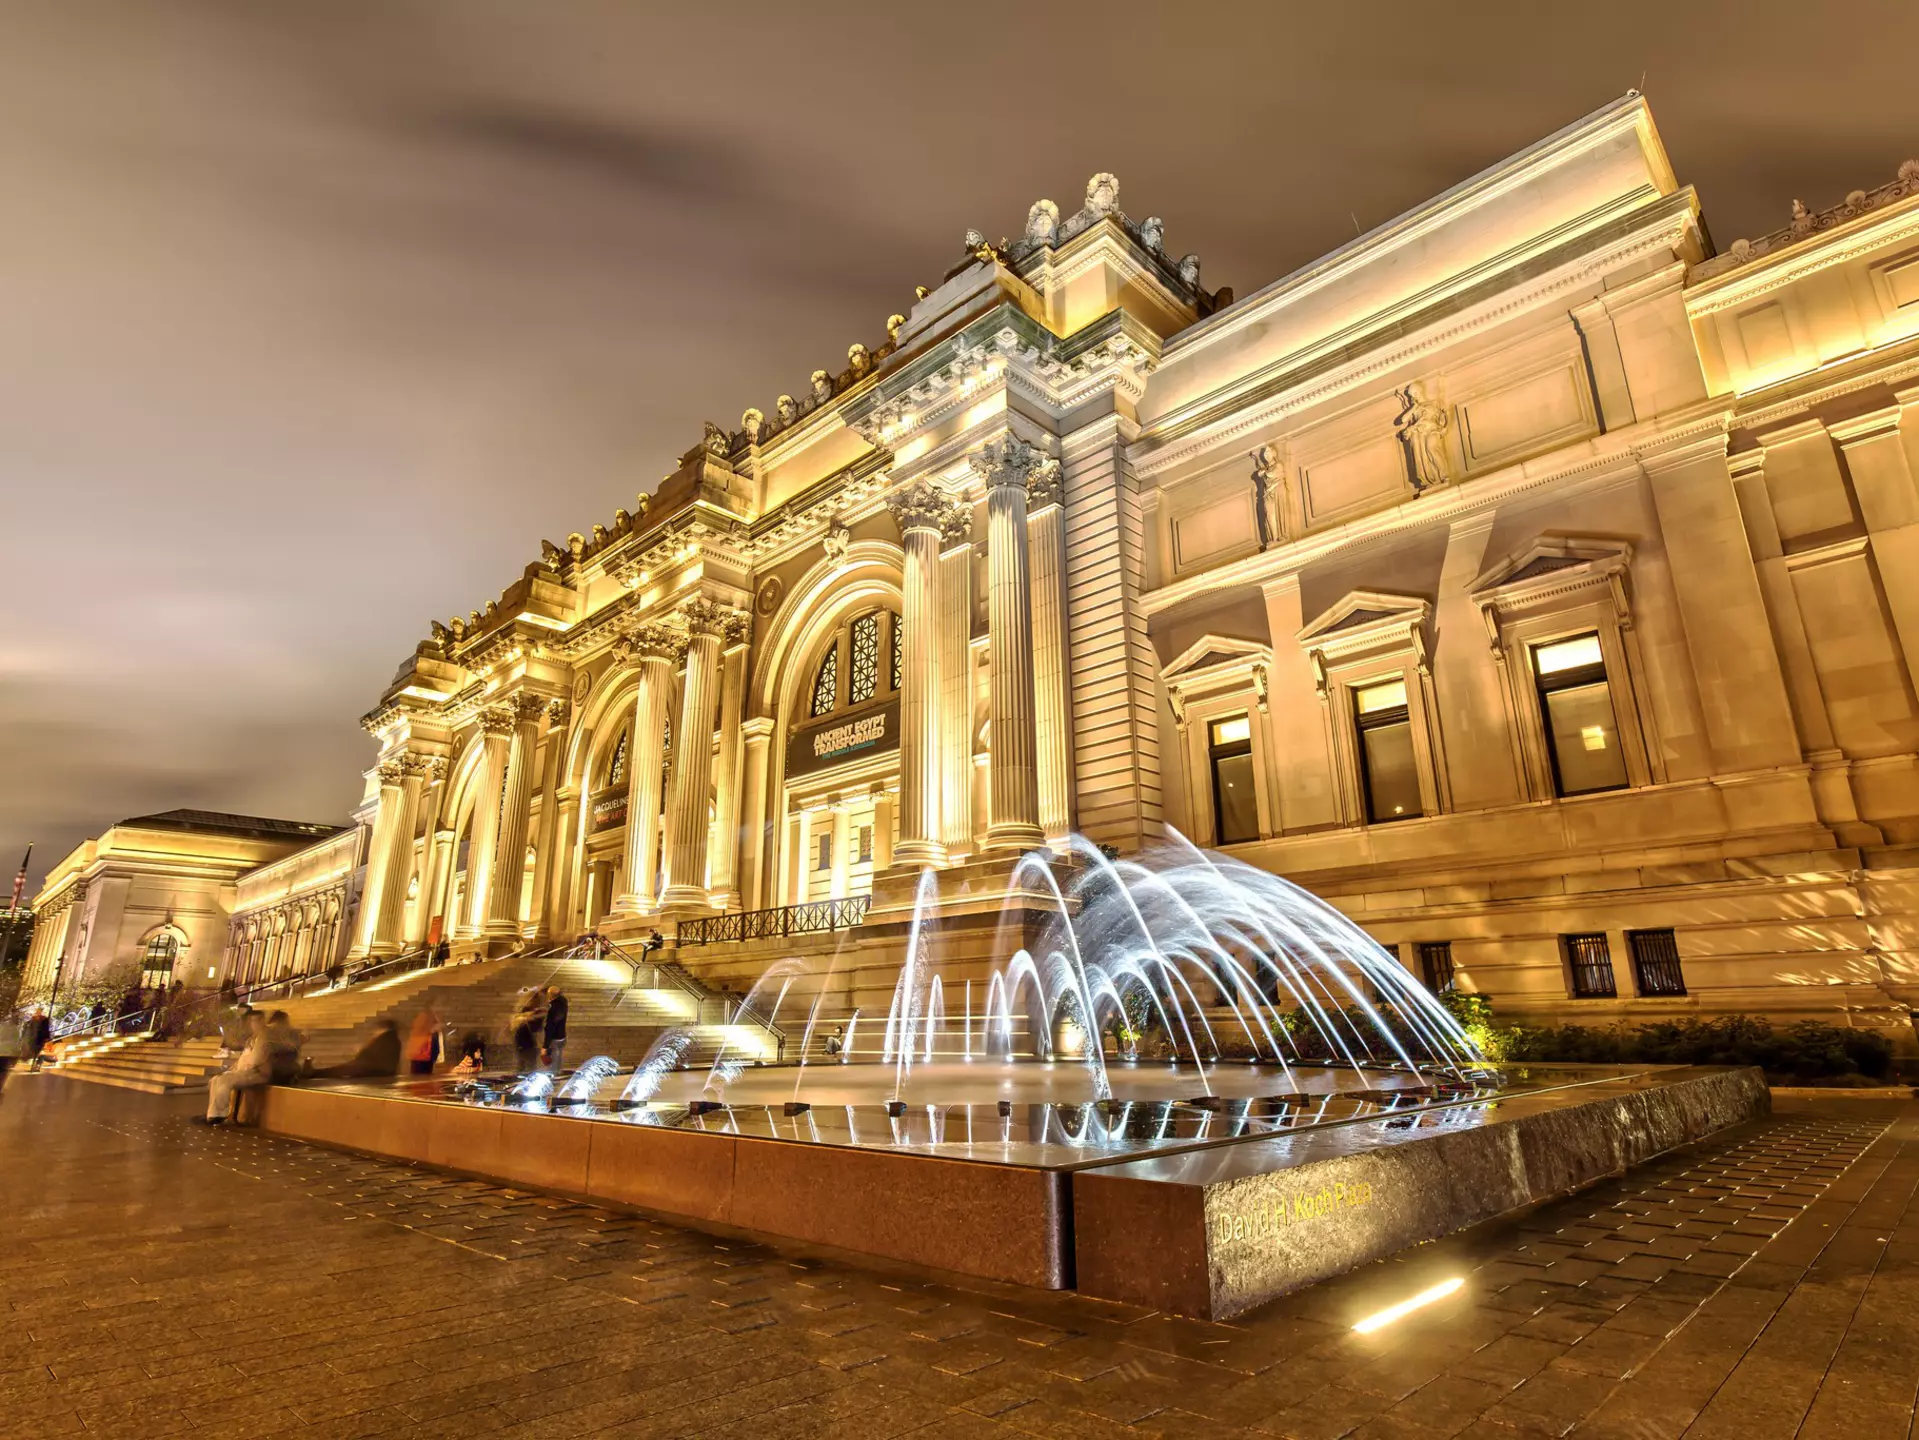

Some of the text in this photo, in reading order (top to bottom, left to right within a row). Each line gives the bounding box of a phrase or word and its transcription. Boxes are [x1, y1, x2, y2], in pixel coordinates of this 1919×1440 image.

[813, 713, 886, 747] ANCIENT EGYPT
[814, 726, 885, 757] TRANSFORMED
[1219, 1202, 1270, 1245] David
[1293, 1186, 1334, 1223] Koch
[1334, 1180, 1373, 1209] Plaza
